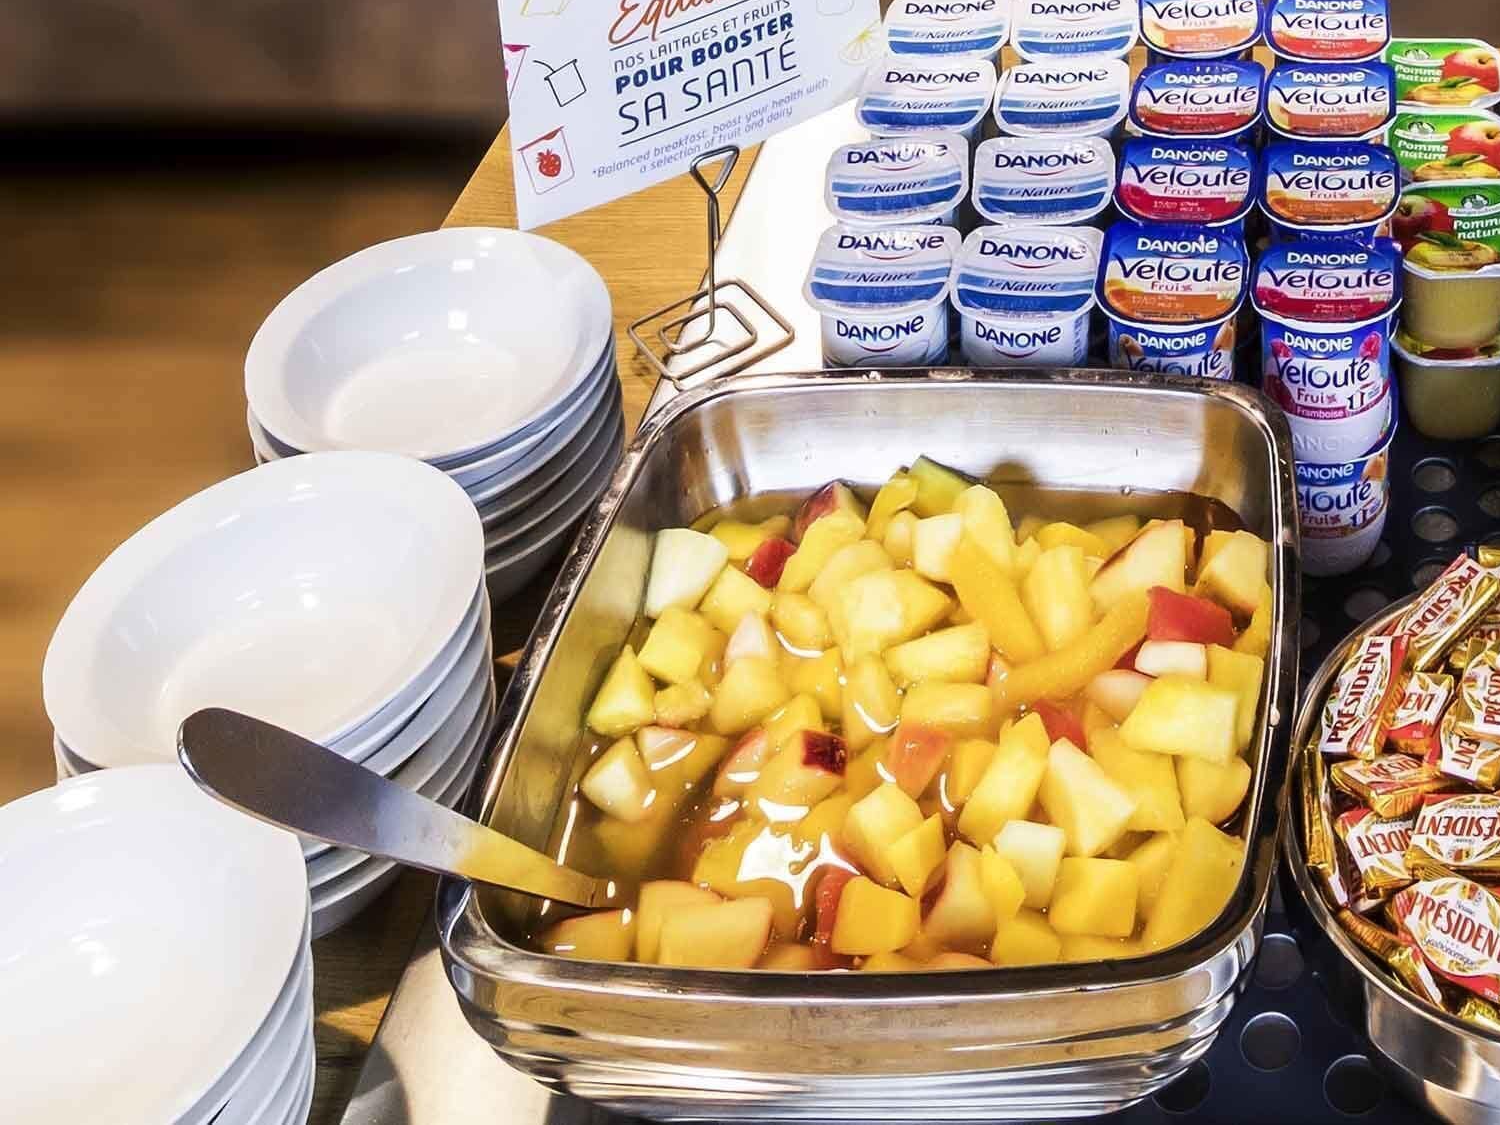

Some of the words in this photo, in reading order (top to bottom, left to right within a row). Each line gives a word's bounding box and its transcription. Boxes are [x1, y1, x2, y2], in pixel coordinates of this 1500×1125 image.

[1277, 10, 1384, 31] Velouté
[650, 24, 718, 60] LAITAGES
[723, 17, 739, 33] ET
[616, 59, 683, 95] POUR
[692, 12, 794, 67] BOOSTER
[1395, 65, 1443, 76] Pomme
[1398, 74, 1441, 83] nature
[619, 91, 667, 136] SA
[683, 33, 798, 113] SANTÉ
[1144, 84, 1257, 105] Velouté
[1274, 81, 1387, 106] Velouté
[1398, 140, 1448, 152] Pomme
[1400, 149, 1446, 160] nature
[1126, 164, 1249, 187] Velouté
[1273, 169, 1393, 191] Velouté
[1114, 254, 1241, 282] Velouté
[1265, 266, 1392, 289] Velouté
[1275, 356, 1370, 388] Velouté
[1297, 406, 1344, 419] Framboise
[1328, 640, 1384, 744] PRÉSIDENT
